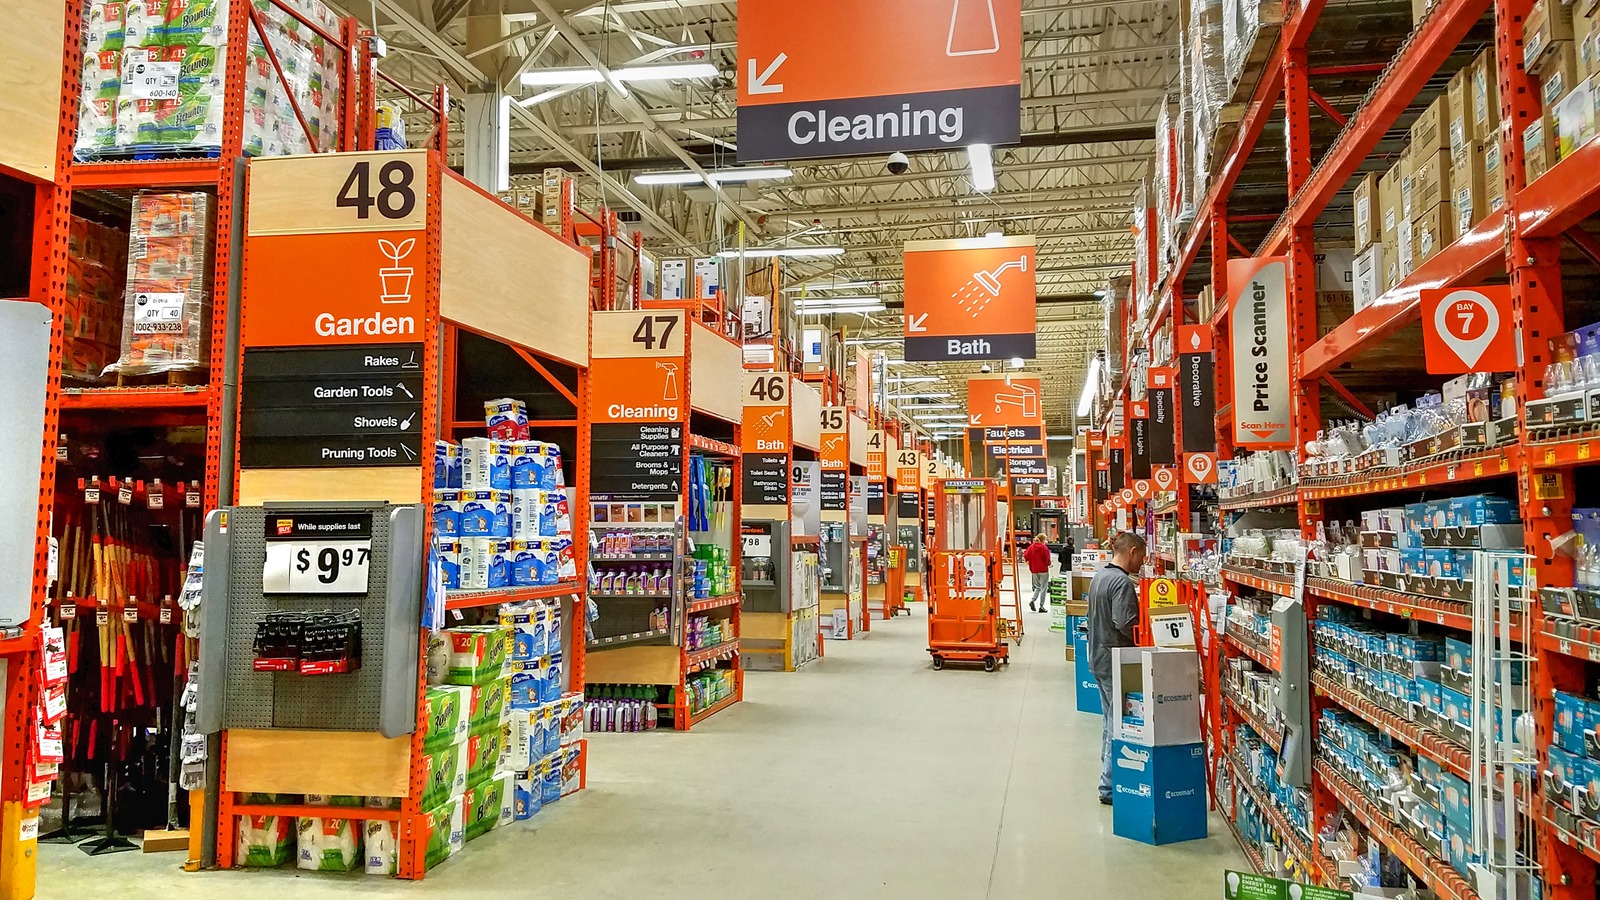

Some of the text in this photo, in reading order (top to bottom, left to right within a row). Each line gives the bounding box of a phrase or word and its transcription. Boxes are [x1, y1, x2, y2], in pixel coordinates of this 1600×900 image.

[111, 6, 120, 15] 15
[182, 6, 212, 29] Bounty
[177, 49, 187, 59] 15
[107, 55, 115, 64] 15
[180, 57, 210, 79] Bounty
[145, 77, 157, 85] QTY
[149, 89, 177, 97] 600-140
[175, 104, 205, 127] Bounty
[787, 103, 964, 144] Cleaning
[336, 160, 416, 221] 48
[1456, 303, 1474, 311] BAY
[147, 310, 159, 318] QTY
[135, 322, 182, 332] 1002-933-238
[315, 312, 415, 336] Garden
[1457, 312, 1474, 334] 7
[632, 315, 679, 350] 47
[947, 339, 991, 356] Bath
[1251, 280, 1269, 412] Price Scanner
[364, 355, 399, 367] Rakes
[1191, 356, 1203, 407] Decorative
[313, 386, 394, 399] Garden Tools
[749, 376, 784, 401] 46
[608, 404, 678, 420] Cleaning
[1156, 391, 1165, 424] Specialty
[354, 416, 398, 428] Shovels
[820, 409, 843, 430] 45
[640, 426, 669, 434] Cleaning
[985, 428, 1026, 438] Faucets
[640, 432, 669, 440] Supplies
[867, 433, 881, 449] 4
[642, 444, 668, 452] Purpose
[756, 440, 784, 450] Bath
[992, 446, 1032, 454] Electrical
[1138, 437, 1146, 455] Lights
[322, 447, 397, 460] Pruning Tools
[821, 459, 844, 468] Bath
[898, 452, 916, 466] 43
[1008, 458, 1036, 466] Storage
[1194, 462, 1204, 470] 11
[650, 468, 668, 476] Mops
[632, 482, 668, 491] Detergents
[318, 522, 346, 532] supplies
[347, 522, 361, 530] last
[296, 547, 369, 584] $ 9 97
[1170, 622, 1180, 638] 6
[461, 638, 472, 647] 20
[1163, 693, 1192, 702] ecosmart
[1190, 748, 1203, 756] LED
[1170, 788, 1195, 798] ecosmart
[1242, 880, 1263, 888] ENERGY
[1242, 884, 1264, 892] Certified
